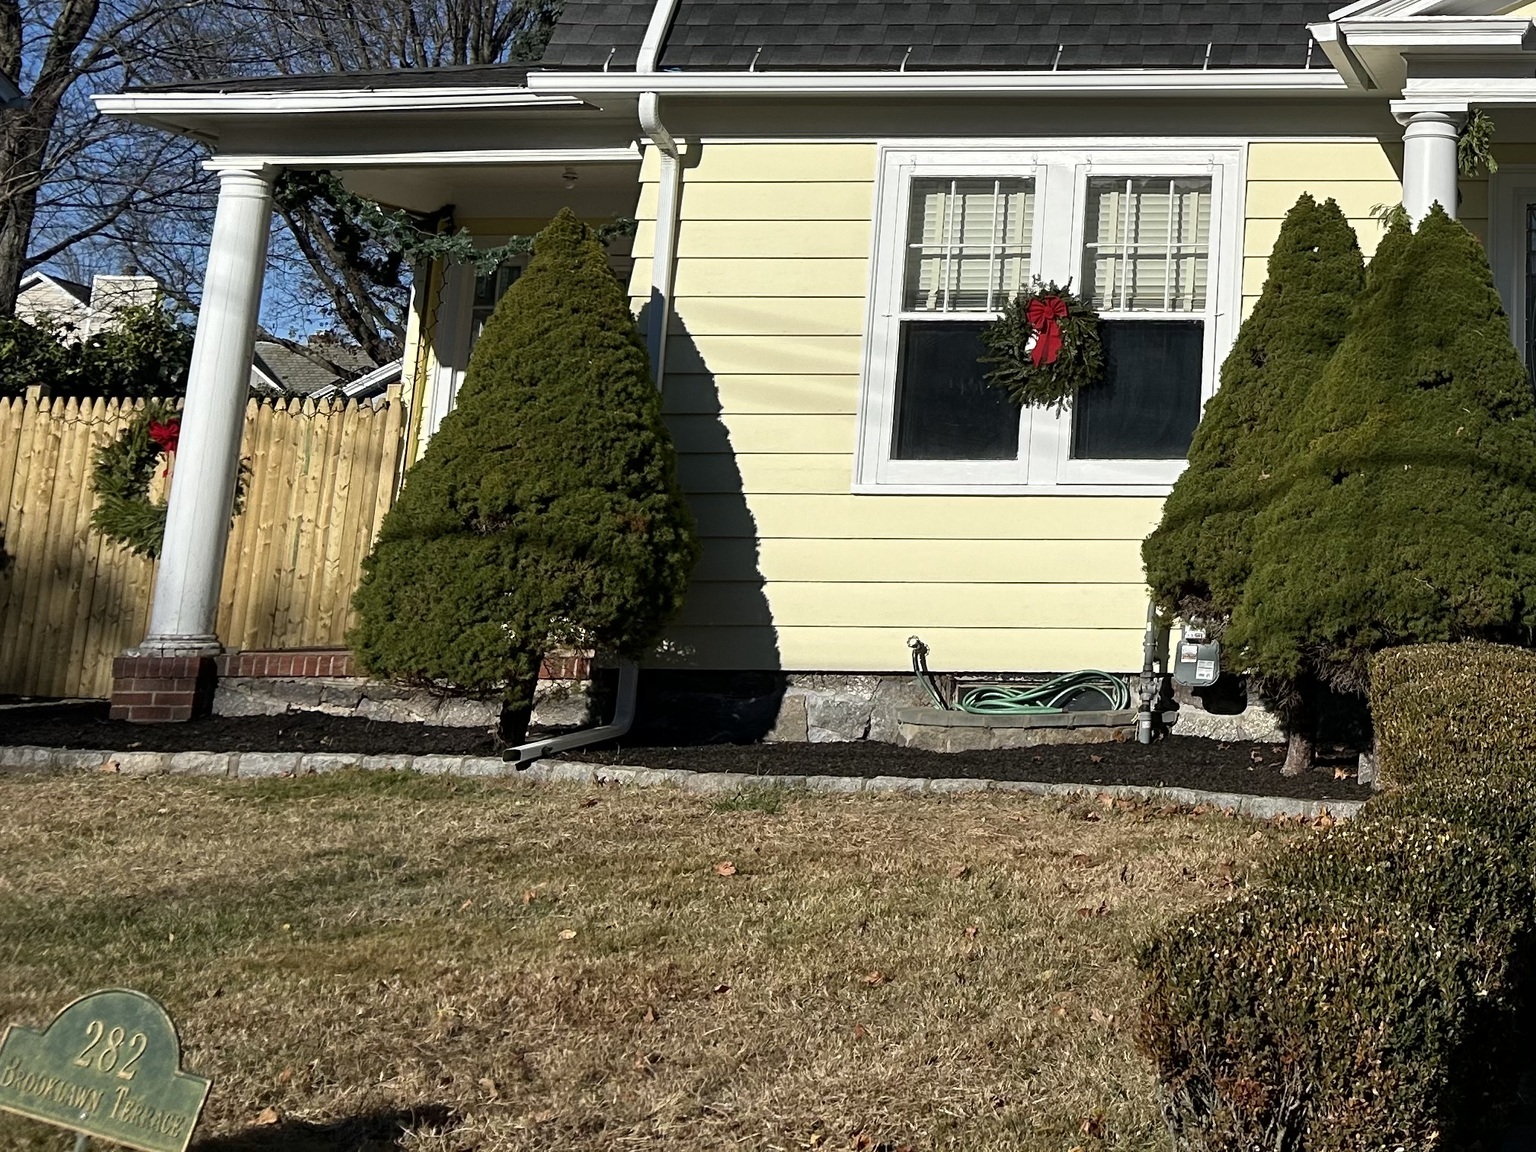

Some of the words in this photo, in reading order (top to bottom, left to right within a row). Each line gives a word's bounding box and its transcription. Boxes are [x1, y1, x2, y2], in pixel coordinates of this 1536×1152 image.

[74, 1020, 148, 1080] 282
[0, 1058, 104, 1113] BROOKLAWN
[110, 1086, 186, 1137] TERRACE
